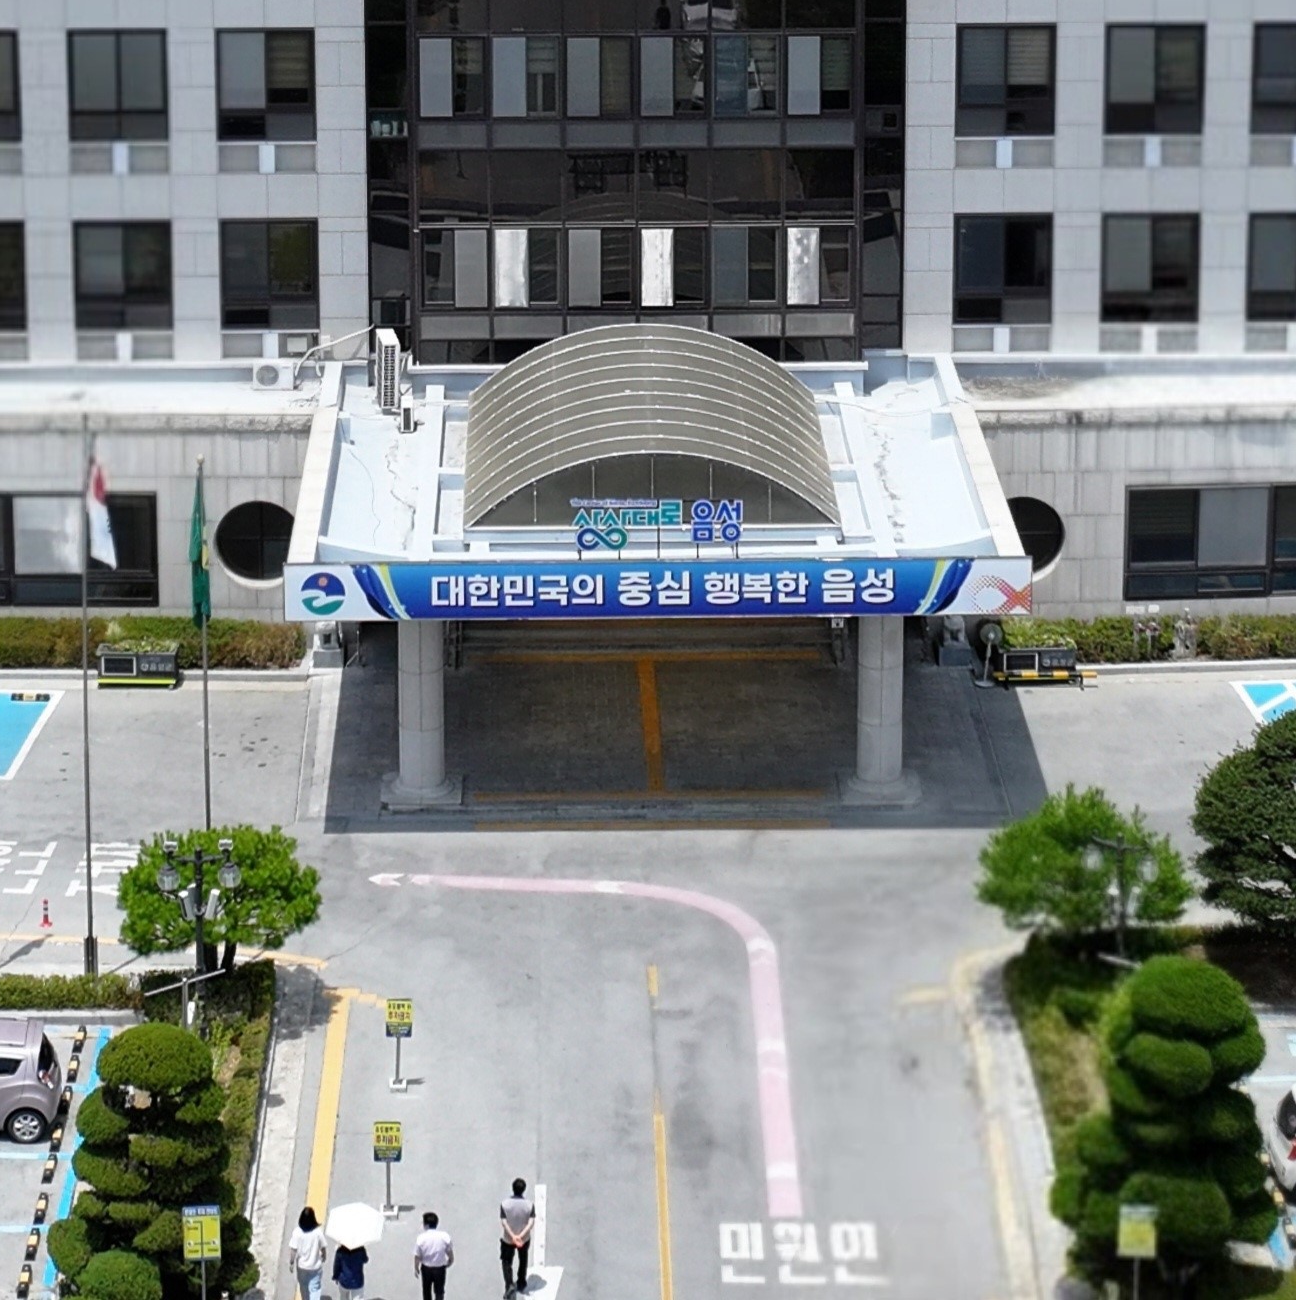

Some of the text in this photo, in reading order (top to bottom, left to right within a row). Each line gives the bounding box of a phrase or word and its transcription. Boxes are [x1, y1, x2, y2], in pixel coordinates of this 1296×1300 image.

[691, 499, 744, 543] 음성
[430, 567, 896, 609] 대한민국의 중심 행복한 음성
[719, 1221, 891, 1285] 민원인
